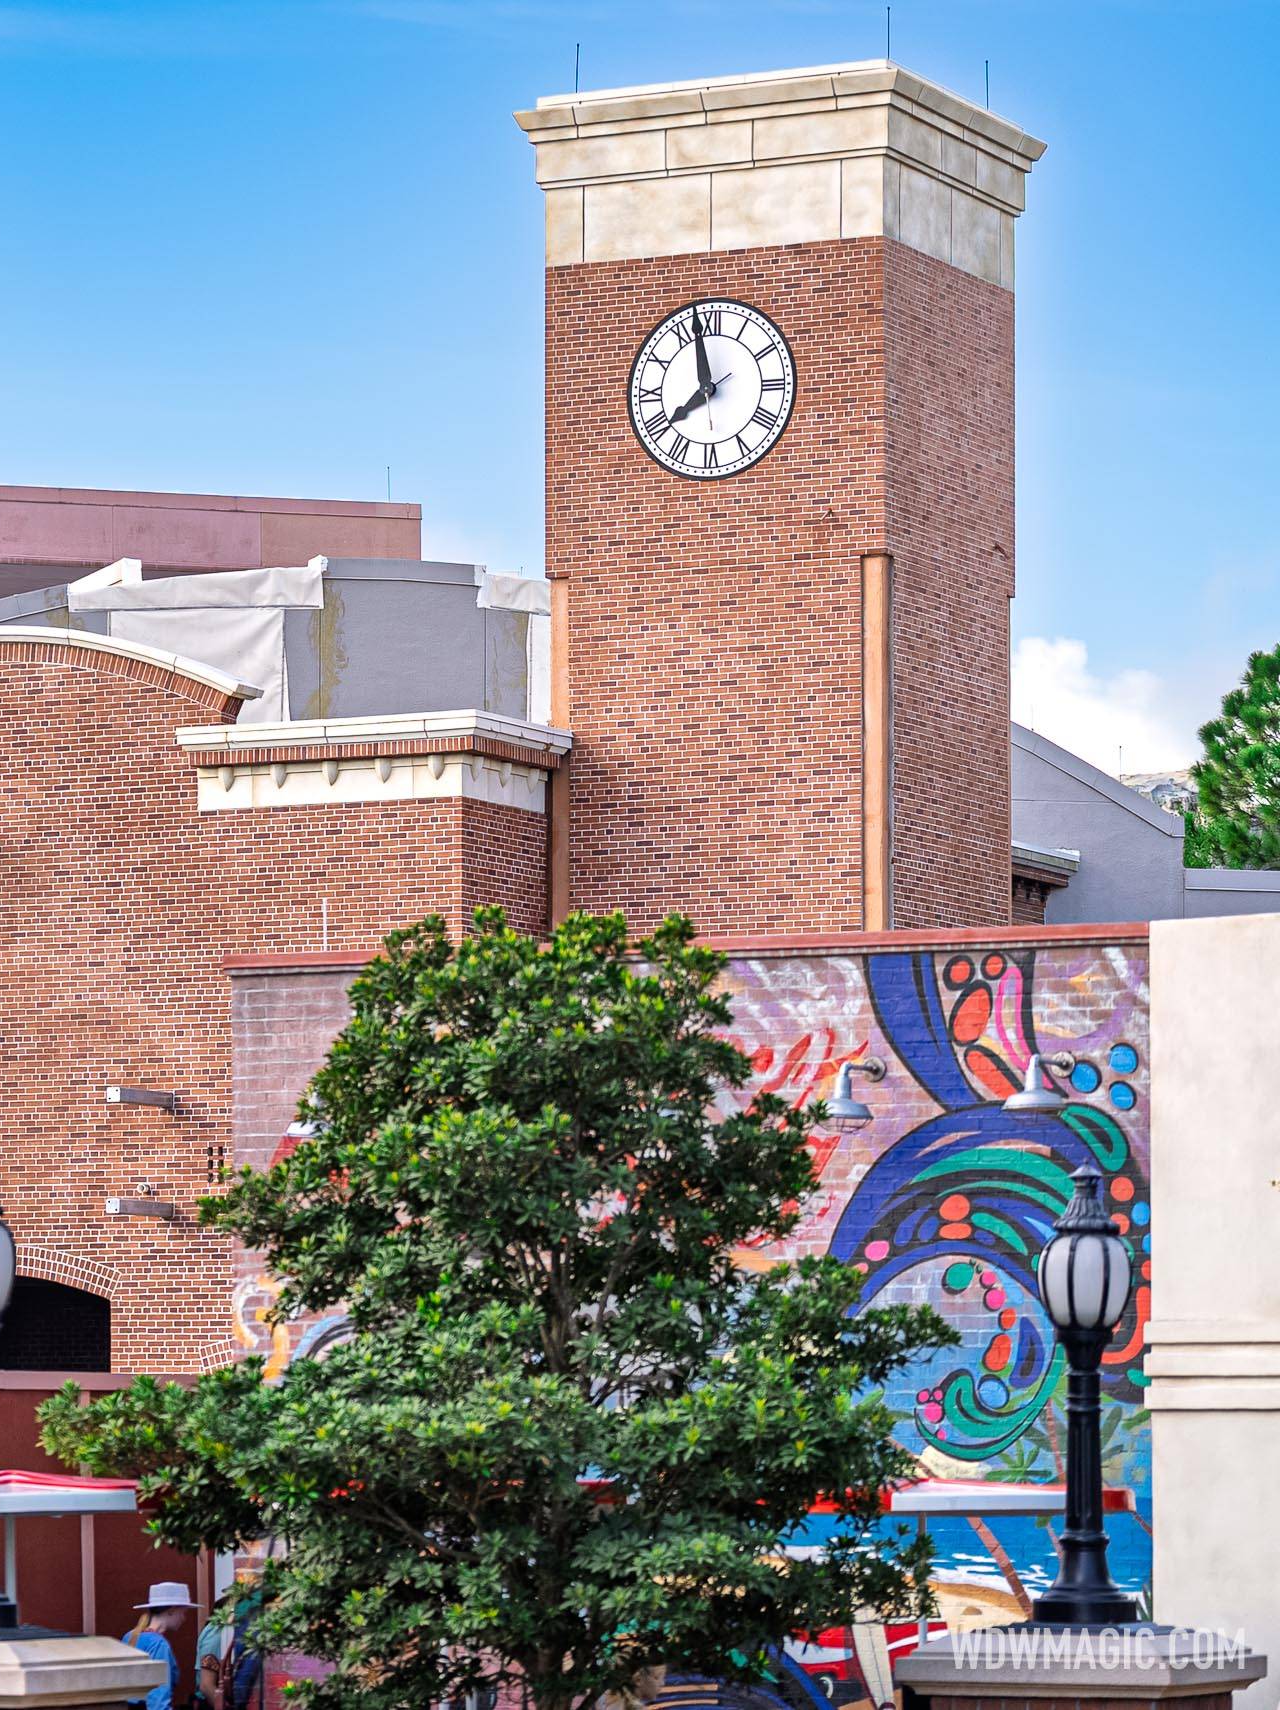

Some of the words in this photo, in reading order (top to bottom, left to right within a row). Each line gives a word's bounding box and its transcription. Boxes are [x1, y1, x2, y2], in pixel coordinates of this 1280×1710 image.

[669, 321, 692, 350] XI
[702, 310, 722, 337] XII
[736, 318, 749, 341] I
[647, 351, 670, 371] X
[753, 343, 777, 361] II
[639, 387, 662, 403] IX
[761, 378, 785, 391] III
[644, 411, 671, 443] VIII
[752, 406, 778, 431] IIII
[668, 434, 690, 463] VII
[704, 443, 719, 468] VI
[736, 434, 752, 457] V
